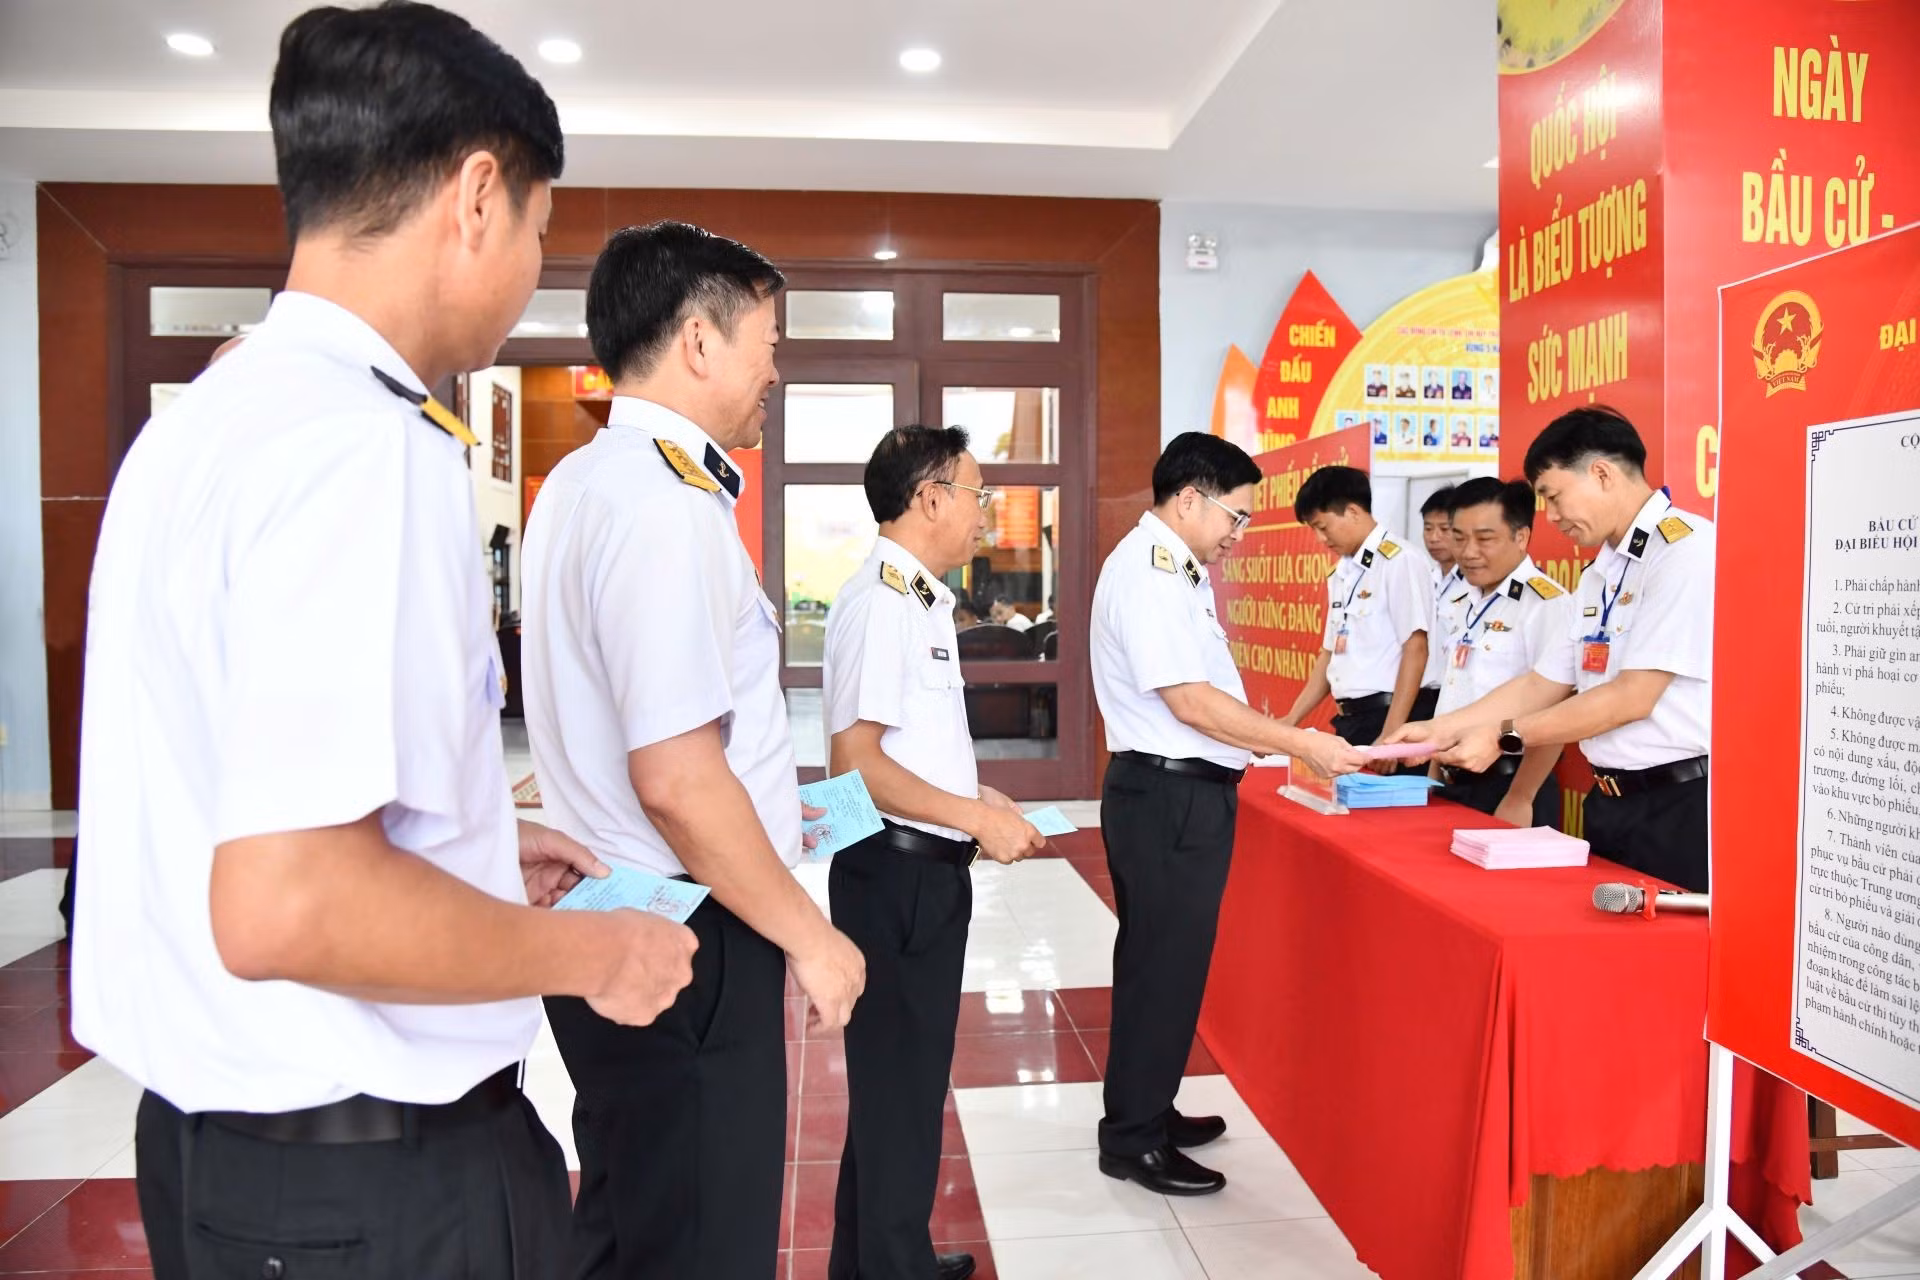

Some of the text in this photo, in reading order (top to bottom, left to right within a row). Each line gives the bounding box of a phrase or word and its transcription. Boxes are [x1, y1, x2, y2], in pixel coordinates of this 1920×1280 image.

[1774, 34, 1869, 122] NGÀY
[1530, 64, 1617, 190] QUỐC HỘI
[1742, 148, 1813, 246] BẦU
[1824, 154, 1875, 248] CỬ
[1509, 178, 1648, 302] LÀ BIỂU TƯỢNG
[1289, 320, 1336, 348] CHIẾN
[1879, 318, 1916, 352] ĐẠI
[1280, 353, 1312, 383] ĐẤU
[1527, 311, 1629, 404] SỨC MẠNH
[1267, 397, 1299, 418] ANH
[1835, 534, 1917, 553] ĐẠI BIỂU HỘI
[1221, 544, 1331, 592] SÁNG SUỐT LỰA CHỌN
[1834, 579, 1843, 591] 1.
[1845, 576, 1867, 591] Phải
[1869, 575, 1895, 595] chấp
[1226, 593, 1322, 634] NGƯỜI XỨNG ĐÁNG
[1833, 602, 1842, 614] 2.
[1863, 603, 1874, 615] tri
[1877, 603, 1900, 618] phải
[1816, 617, 1839, 634] tuổi,
[1840, 622, 1870, 637] người
[1872, 620, 1909, 640] khuyết
[1251, 644, 1273, 674] CHO
[1274, 643, 1307, 682] NHÂN
[1832, 644, 1841, 656] 3.
[1844, 644, 1866, 658] Phải
[1815, 679, 1846, 696] phiếu;
[1816, 662, 1918, 683] hành vi phá hoại cơ
[1830, 705, 1840, 718] 4.
[1842, 706, 1877, 725] Không
[1878, 711, 1906, 728] được
[1830, 728, 1839, 740] 5.
[1841, 729, 1876, 749] Không
[1878, 735, 1906, 752] được
[1813, 745, 1825, 757] có
[1828, 747, 1844, 762] nội
[1847, 750, 1873, 769] dung
[1877, 752, 1900, 772] xấu,
[1812, 783, 1830, 796] vào
[1831, 785, 1850, 800] khu
[1851, 792, 1871, 806] vực
[1873, 794, 1887, 808] bỏ
[1851, 771, 1885, 791] đường
[1889, 774, 1907, 793] lối,
[1827, 808, 1836, 820] 6.
[1838, 809, 1874, 832] Những
[1875, 820, 1907, 837] người
[1827, 829, 1836, 843] 7.
[1840, 832, 1872, 852] Thành
[1875, 842, 1898, 859] viên
[1810, 846, 1834, 861] phục
[1837, 853, 1849, 867] vụ
[1851, 853, 1870, 872] bầu
[1872, 863, 1887, 876] cử
[1889, 866, 1913, 883] phải
[1810, 865, 1829, 879] trực
[1831, 869, 1859, 888] thuộc
[1861, 877, 1893, 901] Trung
[1809, 882, 1821, 895] cử
[1822, 887, 1833, 899] tri
[1835, 889, 1848, 903] bỏ
[1849, 895, 1878, 913] phiếu
[1880, 904, 1893, 918] và
[1894, 909, 1915, 925] giải
[1824, 907, 1833, 921] 8.
[1836, 911, 1869, 934] Người
[1871, 926, 1891, 941] nào
[1808, 920, 1915, 971] bầu cử của công dân,
[1807, 941, 1837, 961] nhiệm
[1839, 953, 1866, 974] trong
[1867, 964, 1893, 984] công
[1895, 973, 1911, 989] tác
[1806, 959, 1830, 977] đoạn
[1831, 967, 1855, 987] khác
[1855, 976, 1869, 992] để
[1870, 982, 1890, 1001] làm
[1891, 994, 1907, 1009] sai
[1806, 976, 1824, 994] luật
[1825, 983, 1837, 999] về
[1838, 989, 1857, 1008] bầu
[1858, 999, 1872, 1014] cử
[1889, 1011, 1907, 1030] tùy
[1805, 996, 1832, 1016] phạm
[1833, 1006, 1857, 1027] hành
[1858, 1018, 1888, 1041] chính
[1889, 1030, 1916, 1053] hoặc
